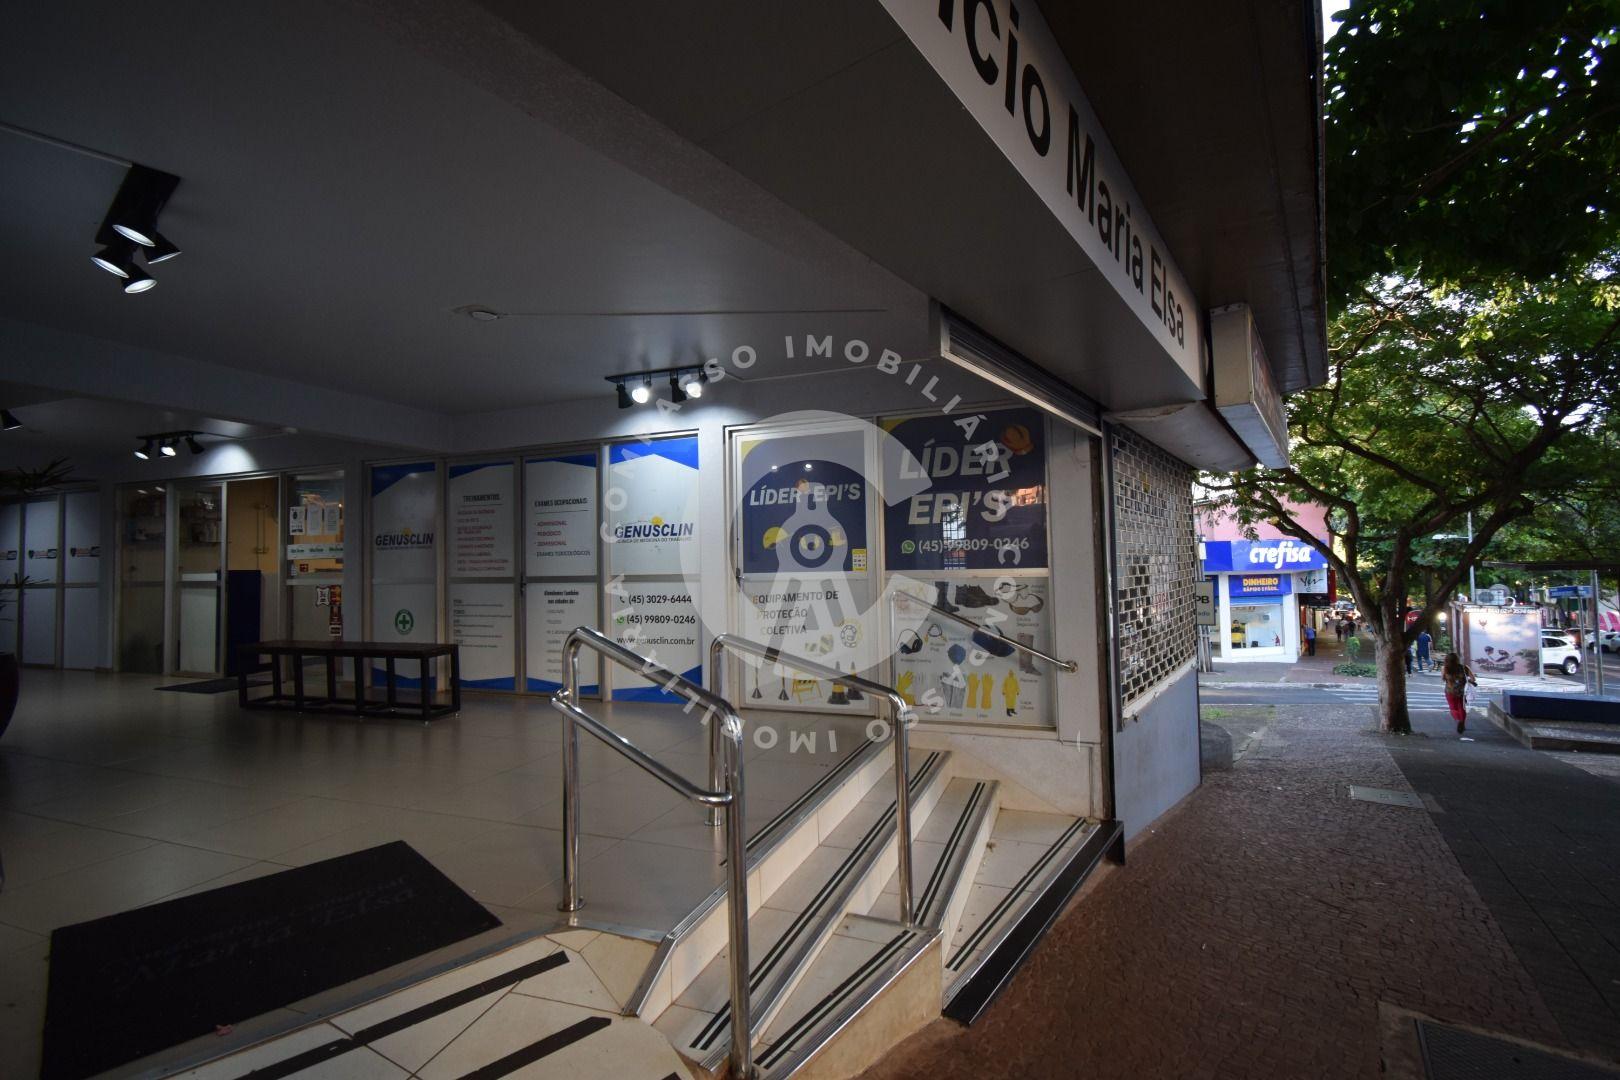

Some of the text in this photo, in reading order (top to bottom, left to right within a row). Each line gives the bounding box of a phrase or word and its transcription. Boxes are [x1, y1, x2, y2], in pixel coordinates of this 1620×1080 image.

[938, 0, 1184, 349] cio Maria Elsa
[899, 437, 1014, 480] LÍDER
[749, 482, 861, 506] LÍDER EPI'S
[908, 489, 1008, 525] EPI'S
[615, 523, 694, 538] GENUSCLIN
[375, 532, 434, 546] GENUSCLIN
[918, 540, 944, 554] (45)
[1250, 541, 1311, 569] crefisa
[1243, 578, 1278, 586] DINHEIRO
[628, 595, 692, 605] (45) 3029-6444
[752, 590, 839, 605] EQUIPAMENTO DE
[626, 615, 696, 624] (45) 99809-0246
[761, 624, 807, 636] COLETIVA
